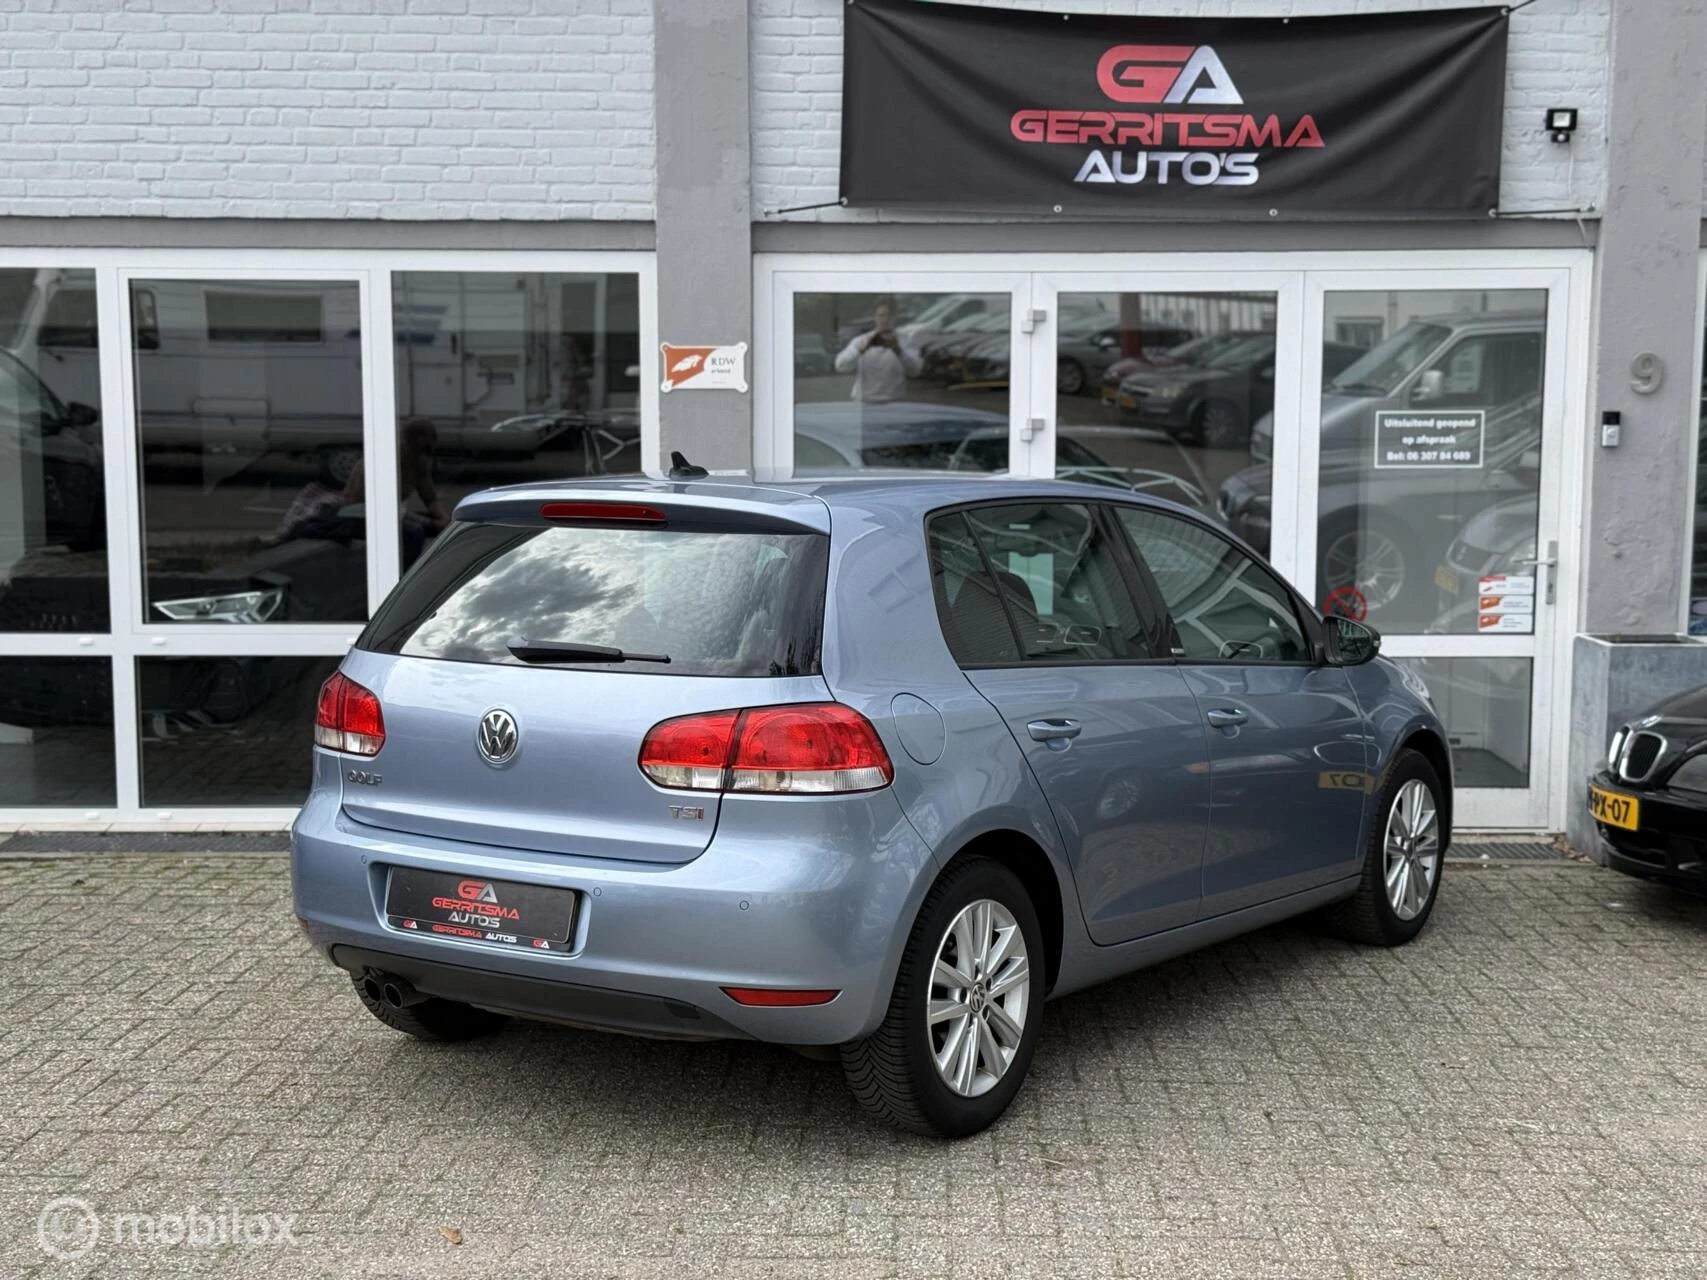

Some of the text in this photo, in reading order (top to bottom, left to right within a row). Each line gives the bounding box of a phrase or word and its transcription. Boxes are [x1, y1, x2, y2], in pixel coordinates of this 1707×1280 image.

[1096, 45, 1244, 105] GA
[1010, 109, 1325, 148] GERRITSMA
[1074, 149, 1260, 186] AUTO'S
[711, 357, 736, 366] RDW
[1630, 352, 1663, 395] 9
[348, 770, 384, 787] GOLF
[668, 805, 704, 821] TSI
[458, 880, 498, 903] GA
[432, 897, 520, 920] GERRITSMA
